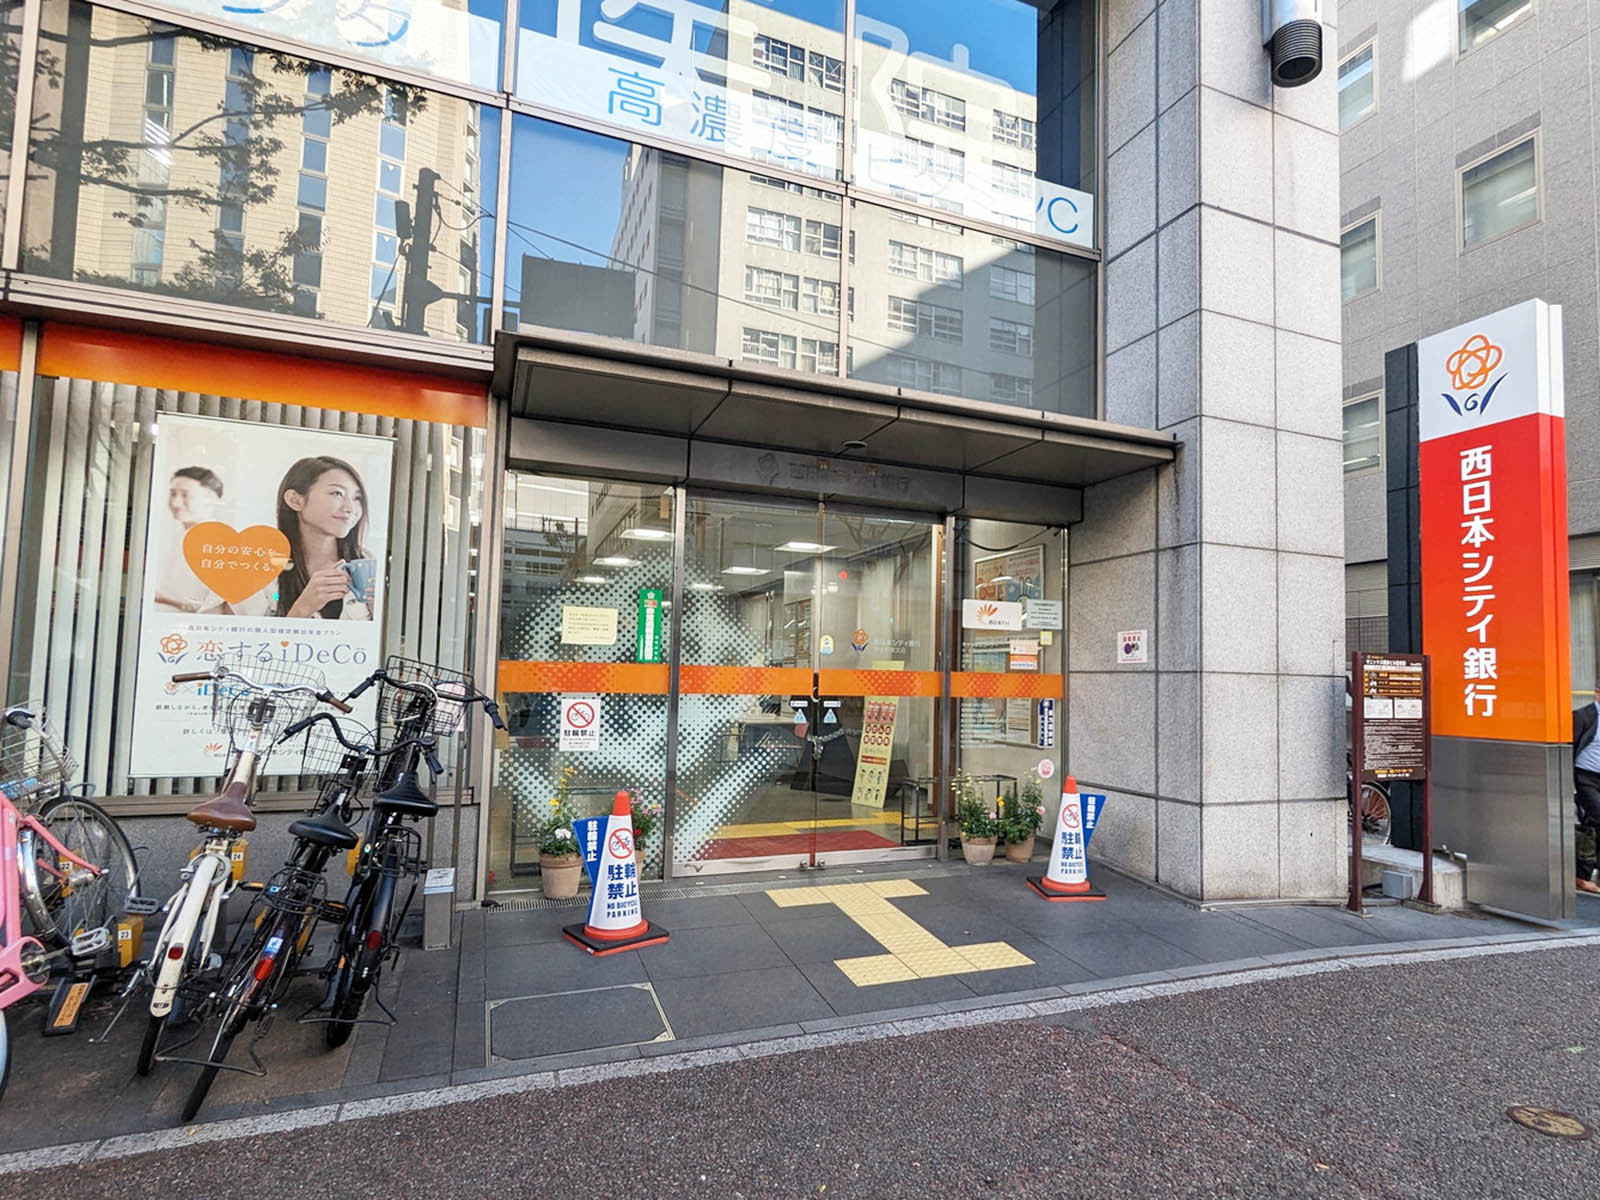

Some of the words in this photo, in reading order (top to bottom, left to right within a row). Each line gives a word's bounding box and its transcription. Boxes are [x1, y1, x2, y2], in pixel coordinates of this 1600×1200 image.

[1459, 444, 1498, 718] 西日本シティ銀行
[564, 729, 595, 737] 駐輪禁止
[586, 820, 599, 862] 駐輪禁止
[1061, 846, 1083, 860] 禁止
[607, 862, 637, 882] 駐輪
[607, 882, 638, 900] 禁止
[606, 902, 616, 911] NO
